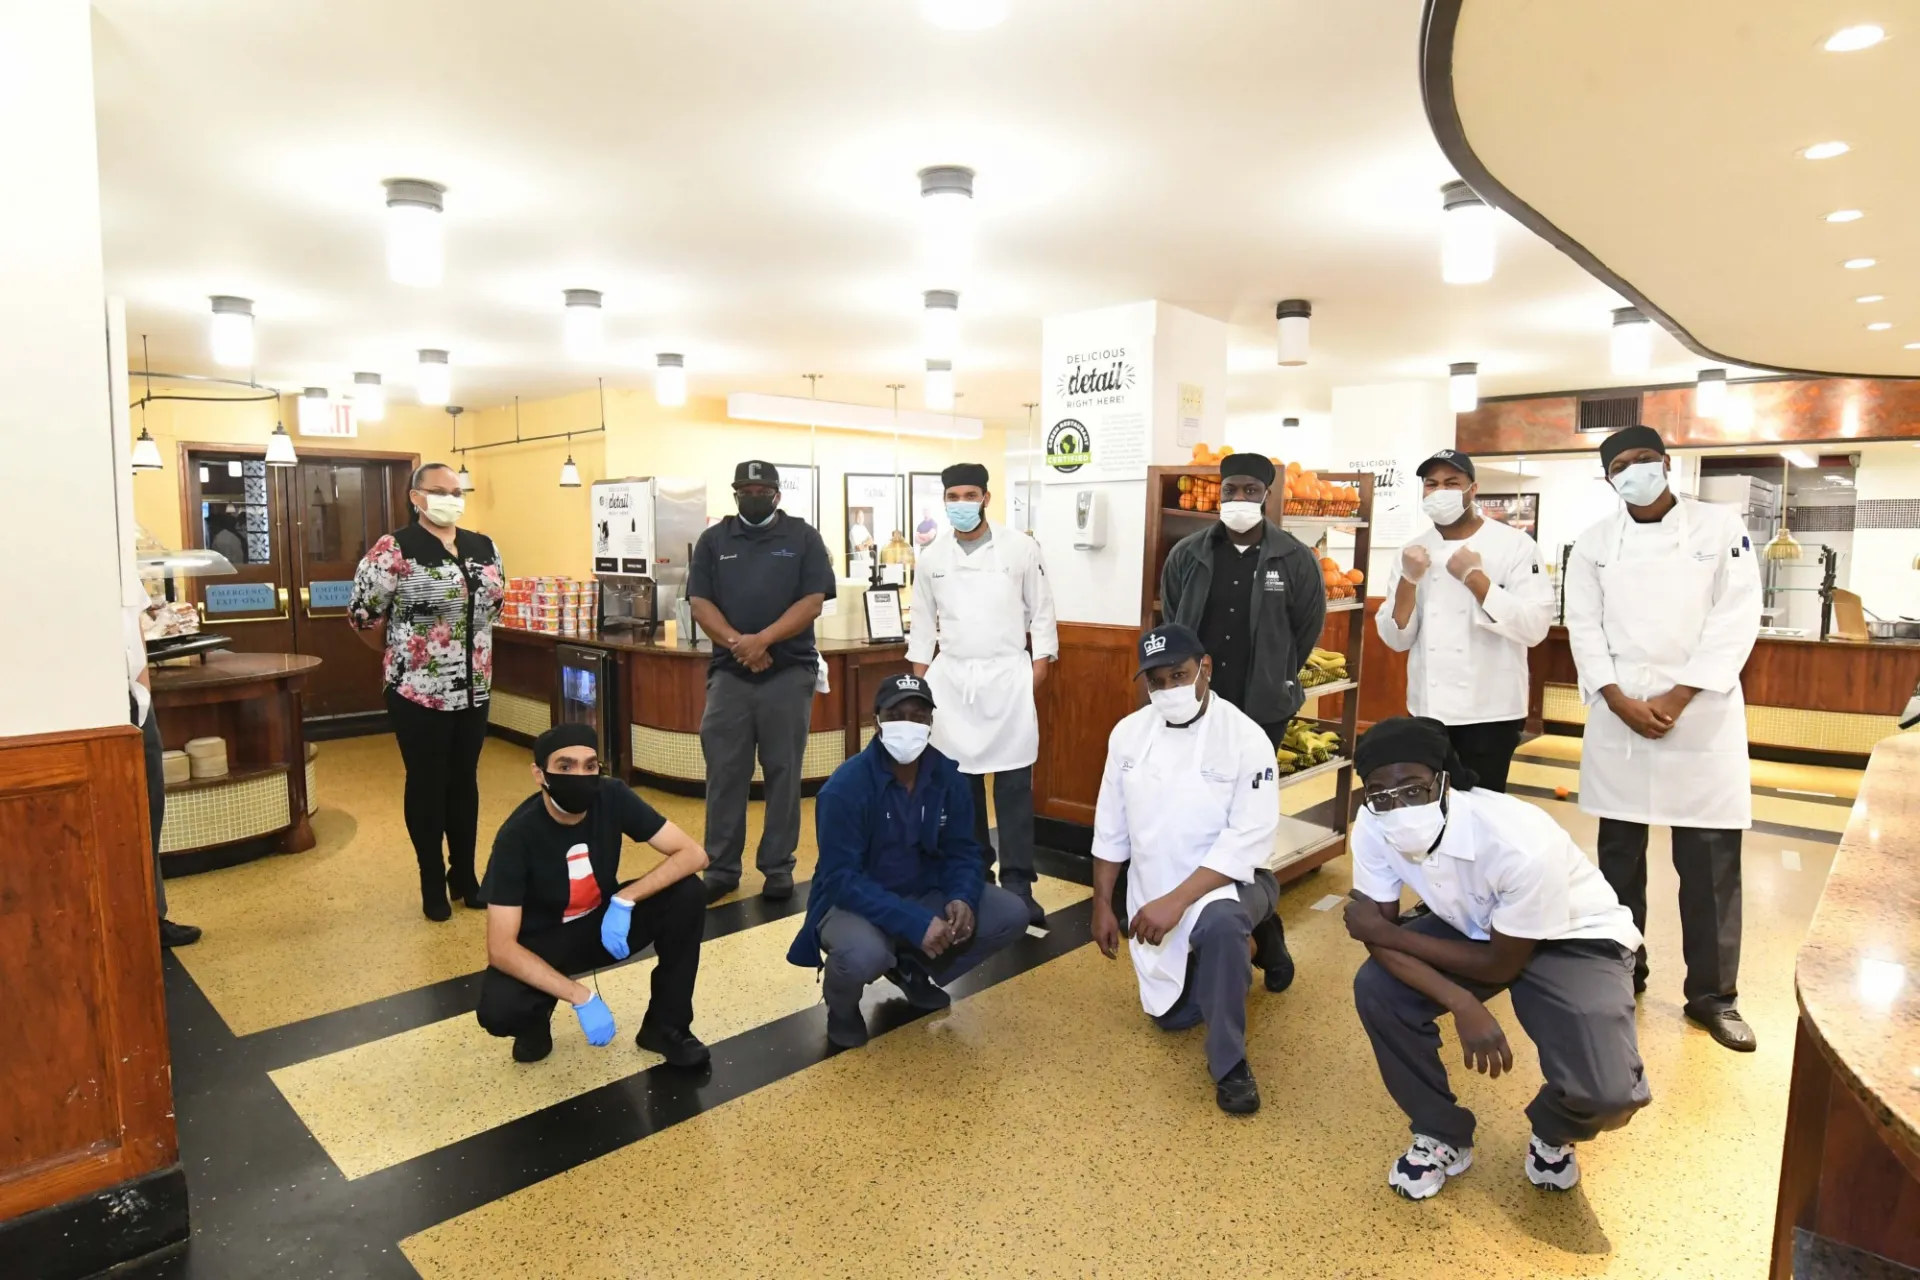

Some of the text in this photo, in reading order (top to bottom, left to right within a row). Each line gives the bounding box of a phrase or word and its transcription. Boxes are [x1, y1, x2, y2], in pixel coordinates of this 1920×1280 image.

[1066, 348, 1126, 364] DELICIOUS
[1068, 361, 1123, 395] detail
[1067, 395, 1125, 408] RIGHT HERE!
[1047, 425, 1060, 449] GREEN
[1060, 420, 1090, 446] RESTAURANT
[1047, 454, 1089, 465] CERTIFIED
[1349, 460, 1397, 469] DELICIOUS
[748, 462, 761, 480] C
[608, 493, 629, 509] detail
[211, 588, 271, 598] EMERGENCY
[315, 585, 351, 594] EMERGE
[216, 596, 268, 606] EXIT ONLY
[318, 593, 341, 601] EXIT
